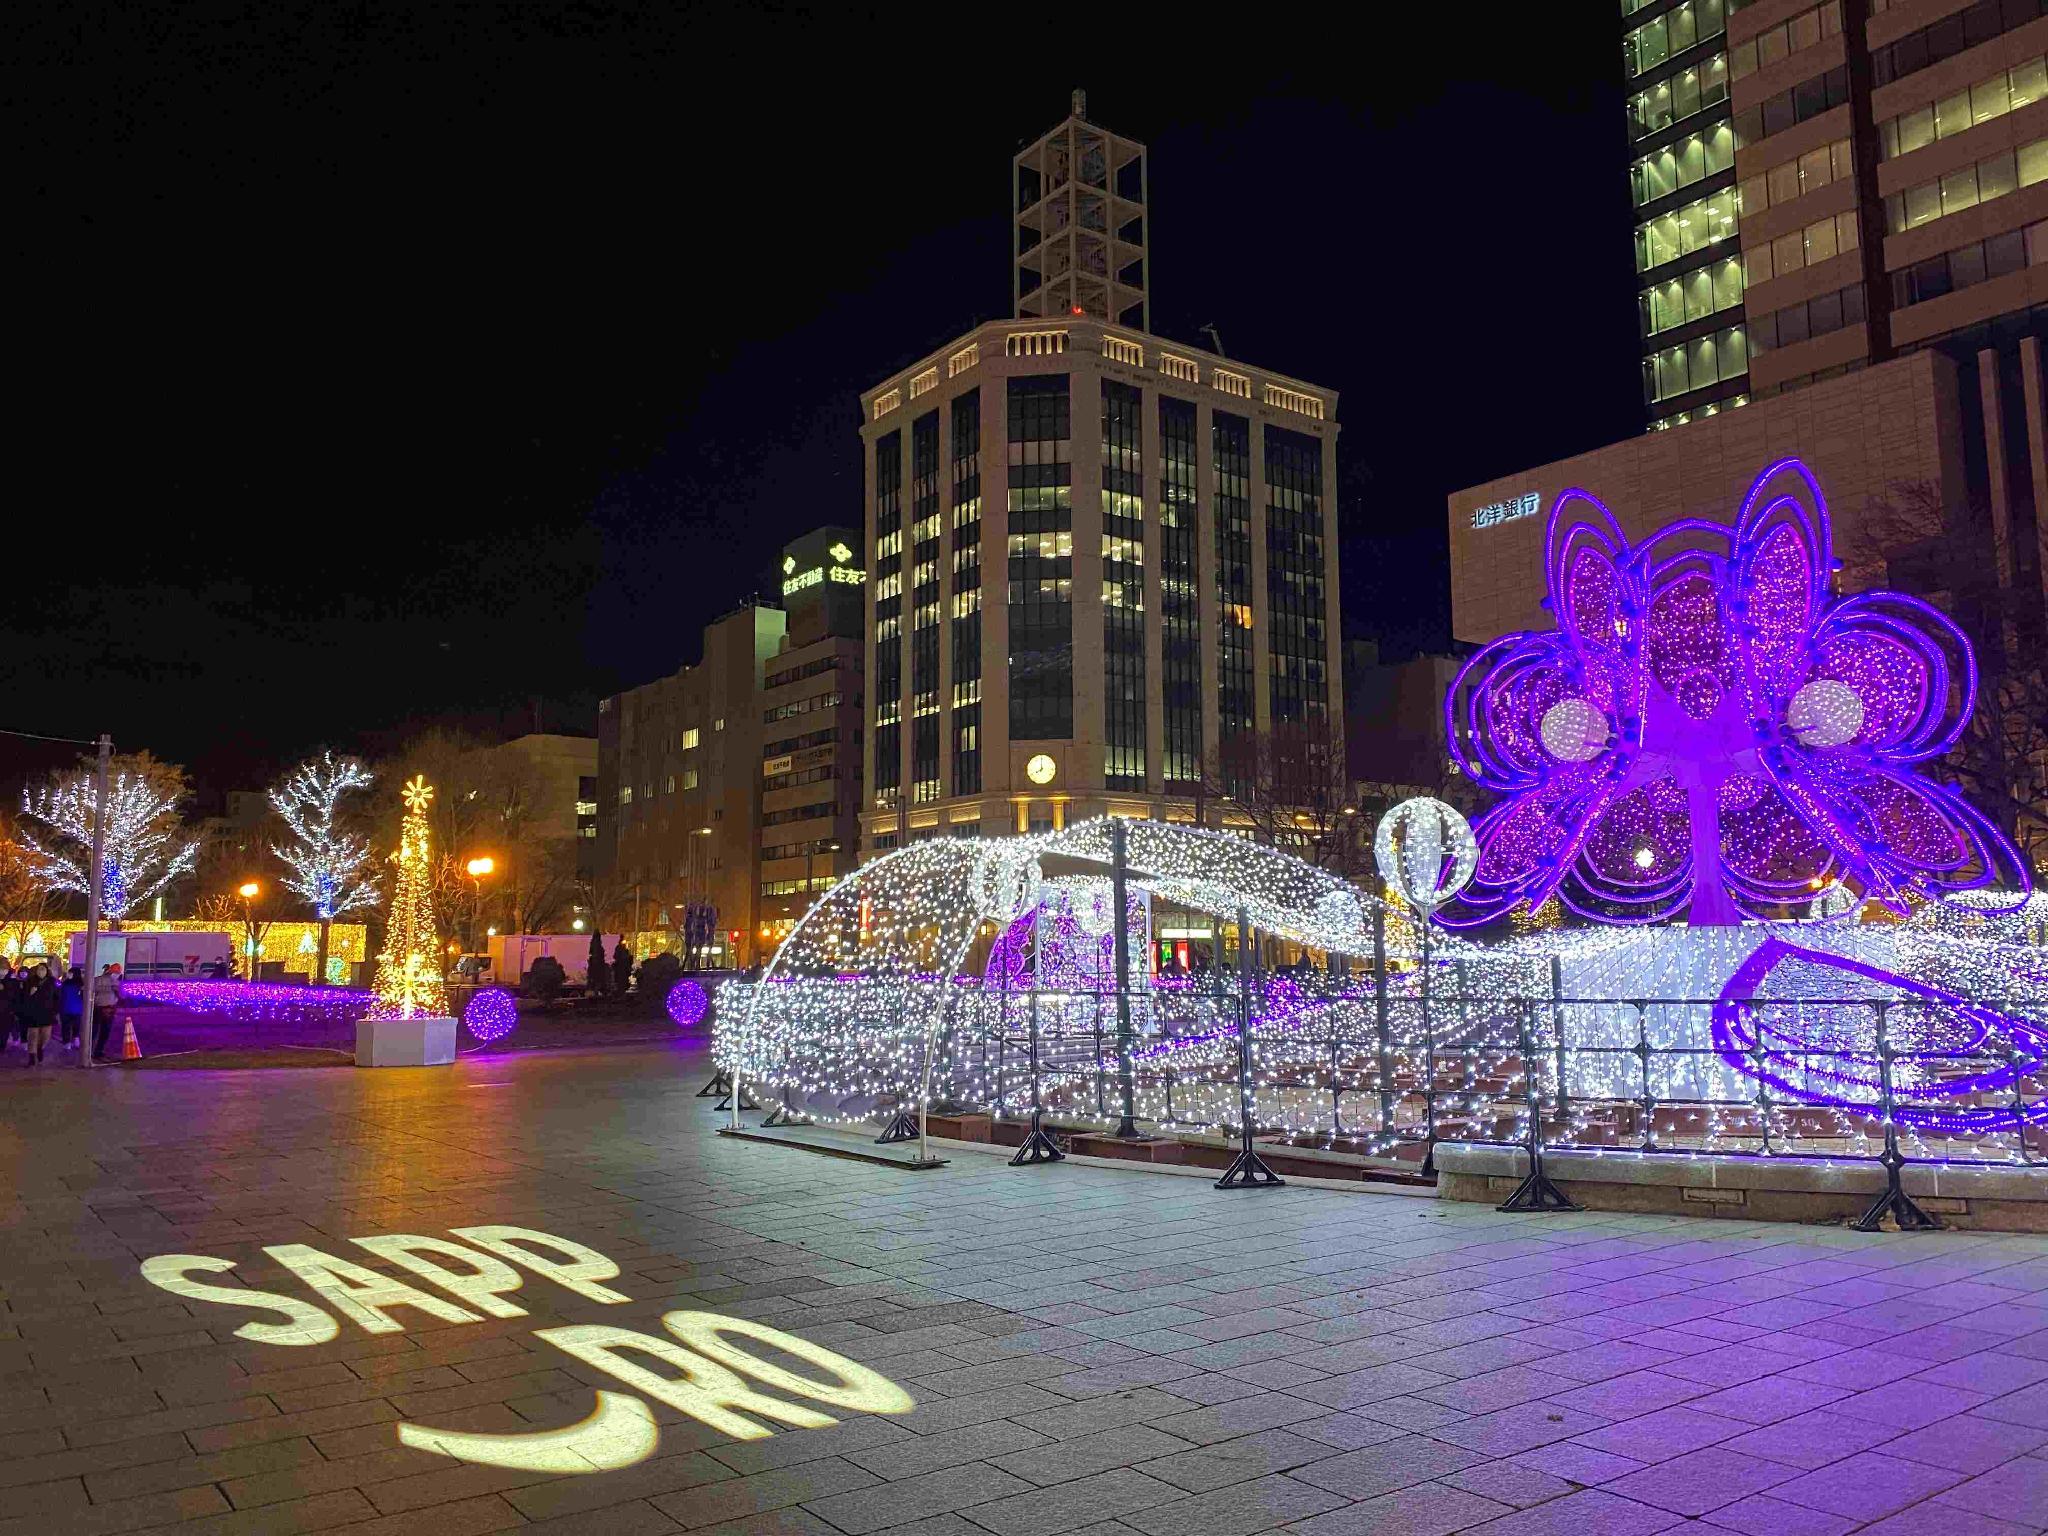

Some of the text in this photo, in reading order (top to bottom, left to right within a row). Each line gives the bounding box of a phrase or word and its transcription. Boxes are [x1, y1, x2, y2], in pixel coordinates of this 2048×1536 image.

[1471, 492, 1539, 527] 北洋銀行
[784, 567, 823, 595] 住友不動産
[140, 1225, 632, 1346] SAPP
